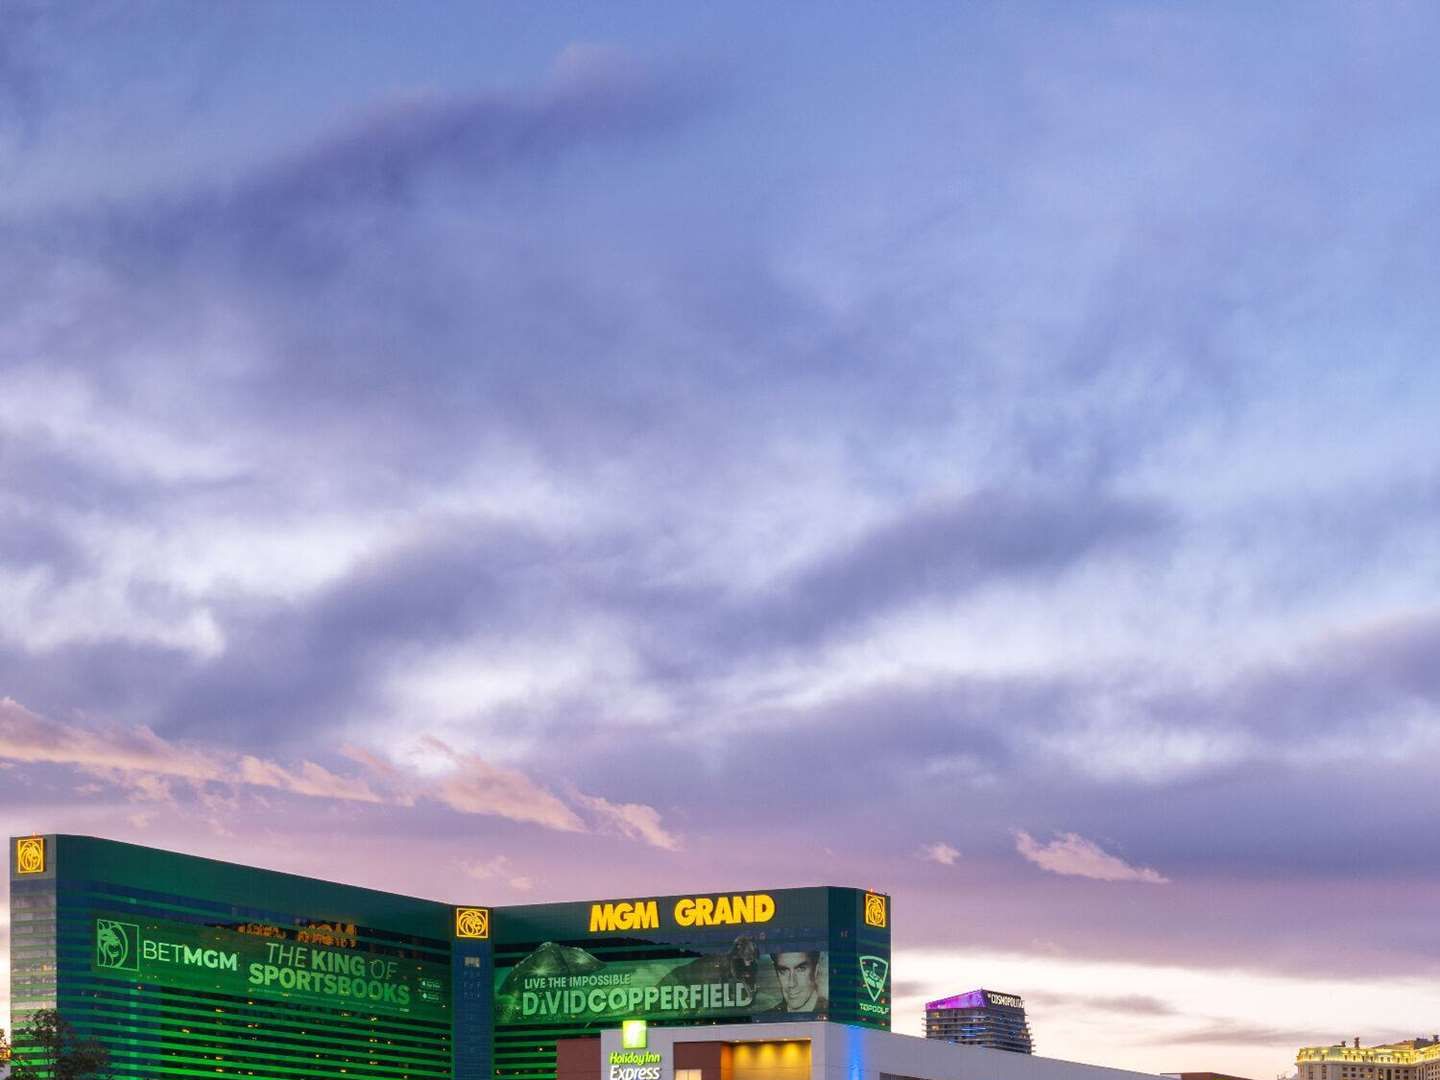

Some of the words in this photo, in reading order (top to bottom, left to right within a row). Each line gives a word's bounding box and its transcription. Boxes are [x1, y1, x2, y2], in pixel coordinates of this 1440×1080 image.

[589, 900, 659, 932] MGM
[674, 894, 776, 927] GRAND
[143, 940, 238, 971] BETMGM
[266, 942, 308, 969] THE
[311, 949, 366, 977] KING
[370, 959, 399, 980] OF
[248, 962, 411, 1005] SPORTSBOOKS
[524, 977, 546, 989] LIVE
[549, 976, 567, 988] THE
[569, 974, 632, 987] IMPOSSIBLE
[859, 1003, 889, 1014] TOPGOLF
